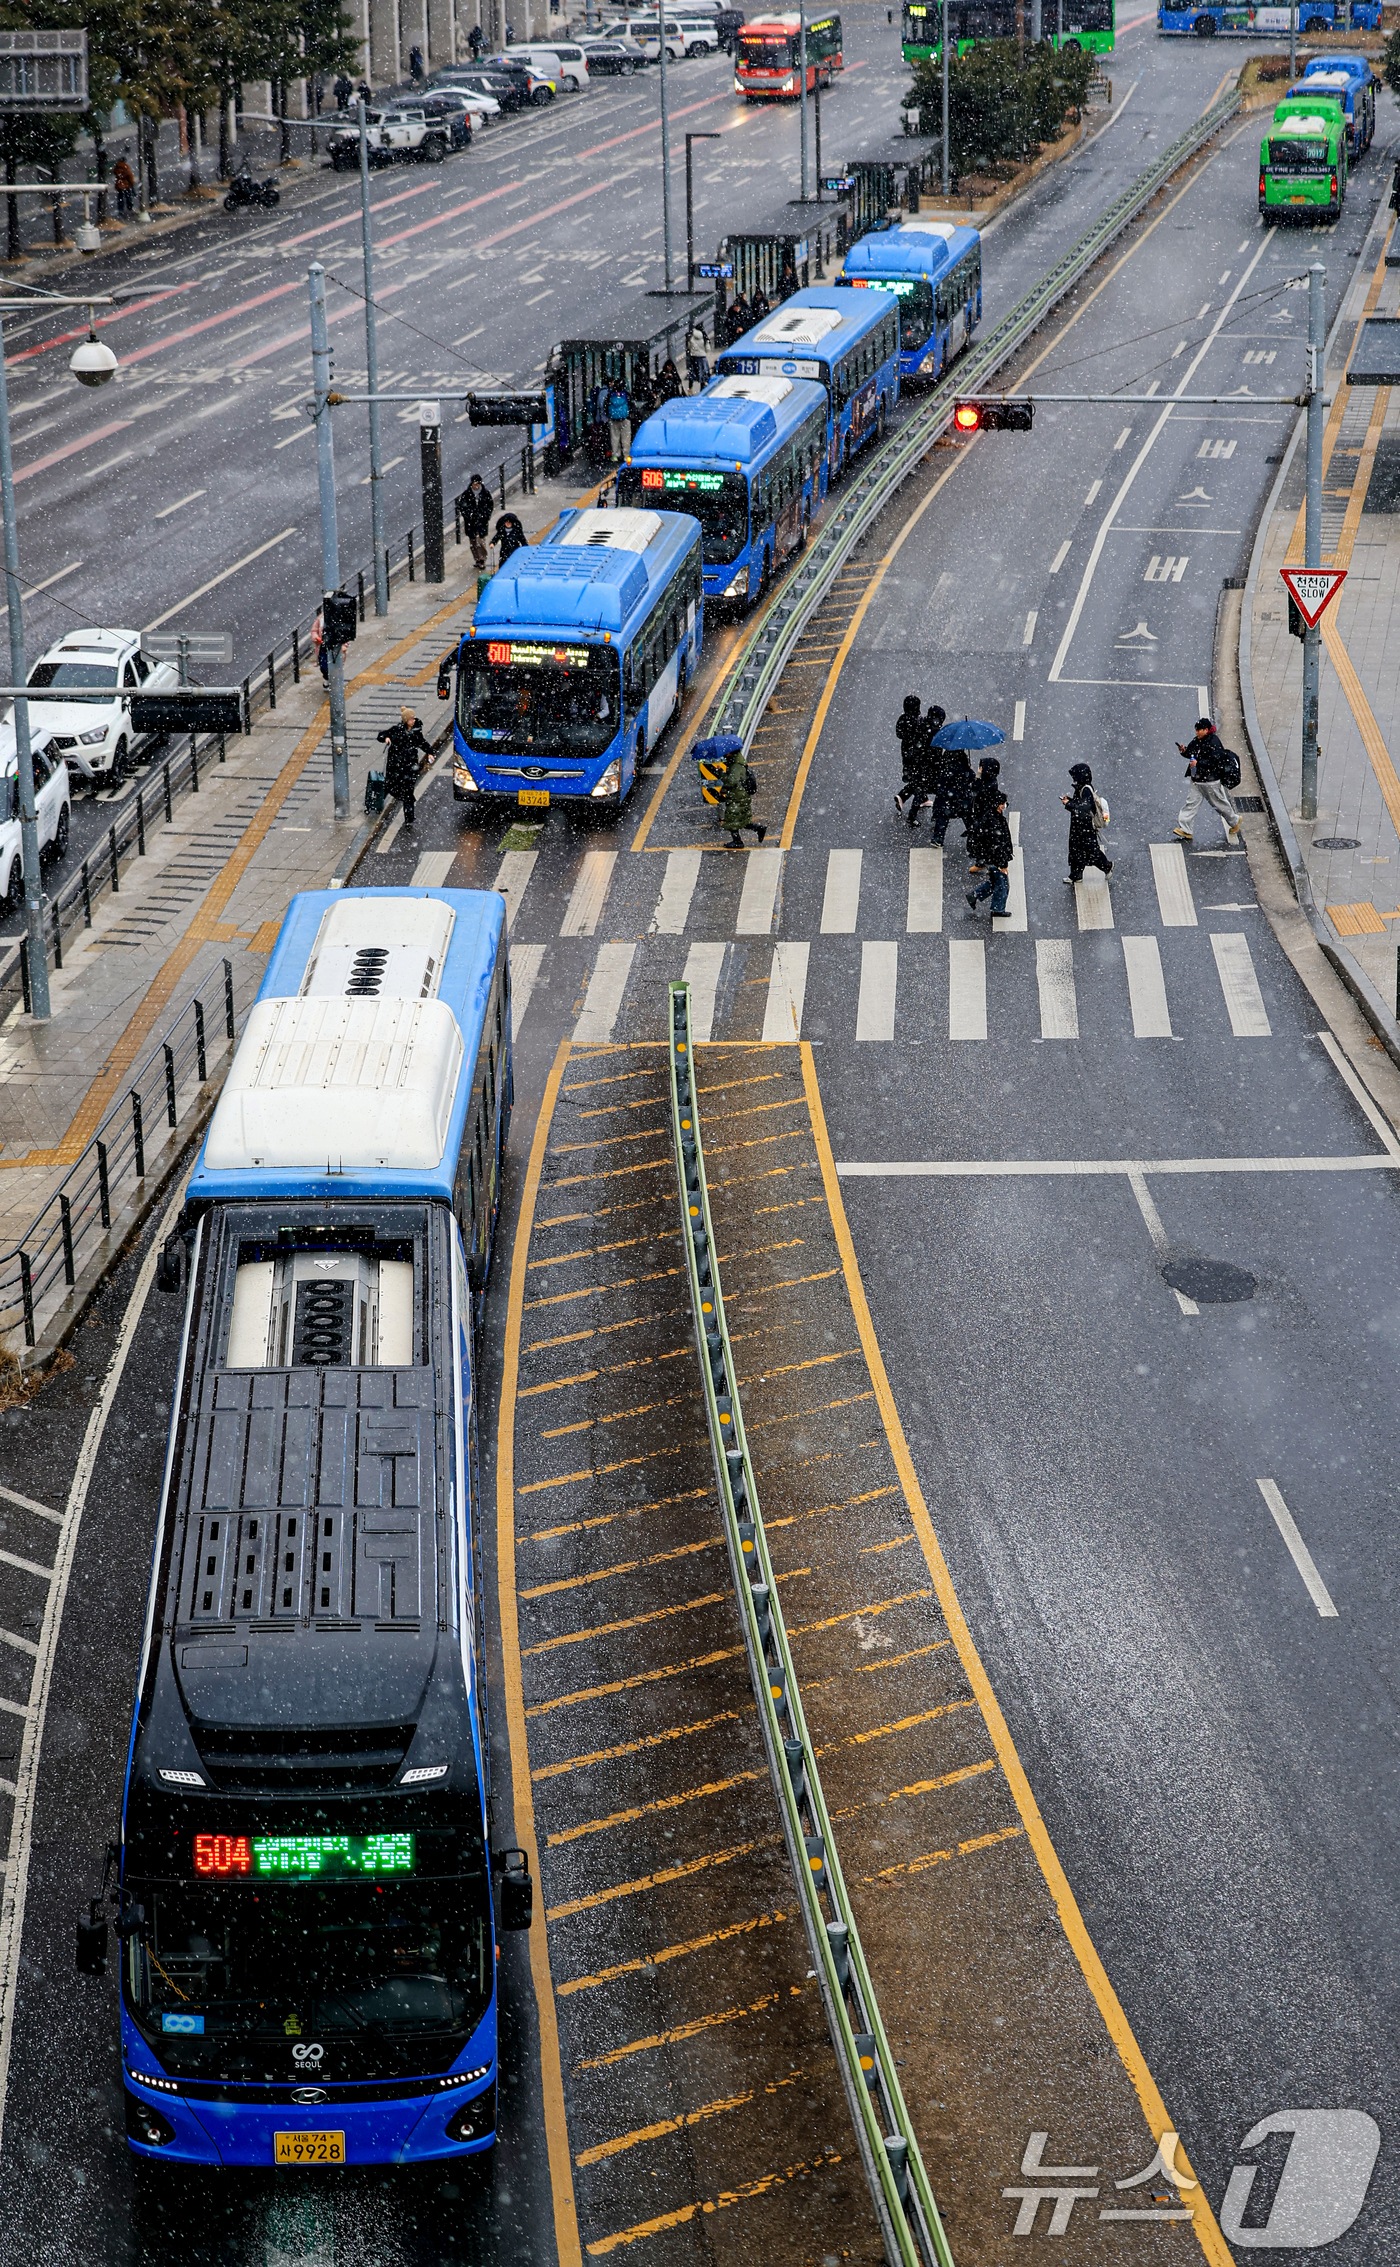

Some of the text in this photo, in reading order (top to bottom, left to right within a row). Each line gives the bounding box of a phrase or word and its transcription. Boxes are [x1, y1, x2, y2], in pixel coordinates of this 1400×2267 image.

[741, 360, 759, 374] 151
[642, 470, 663, 487] 506
[1296, 577, 1329, 588] 천천히
[1301, 589, 1325, 598] SLOW
[489, 643, 511, 663] 501
[196, 1834, 250, 1871] 504
[292, 2043, 324, 2060] GO
[292, 2134, 327, 2142] 서울 74
